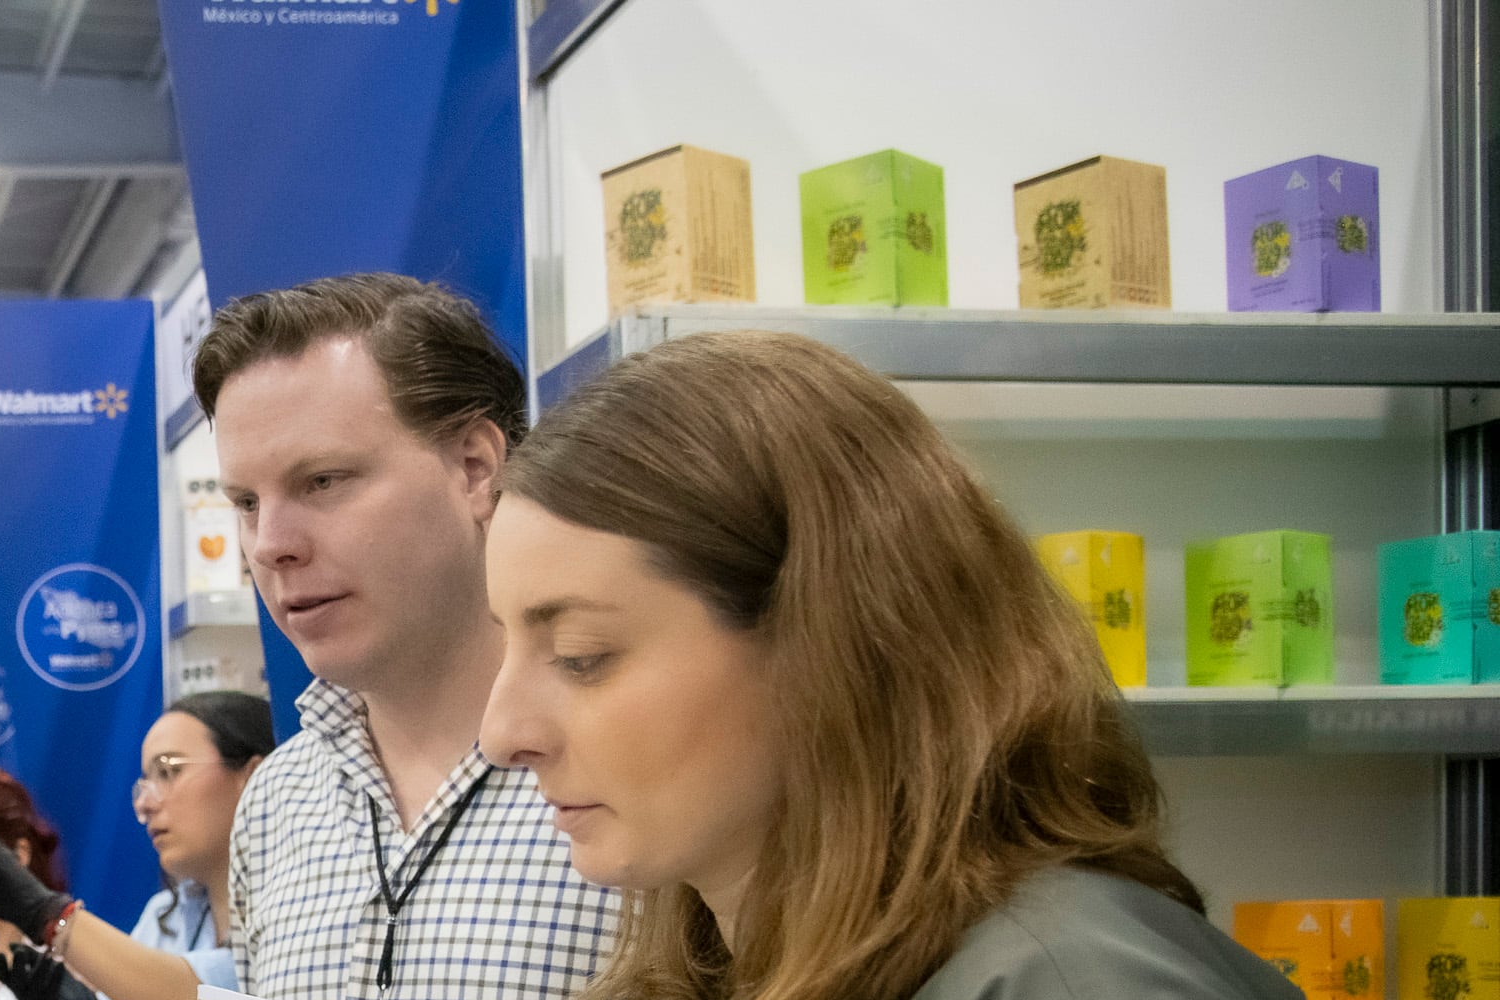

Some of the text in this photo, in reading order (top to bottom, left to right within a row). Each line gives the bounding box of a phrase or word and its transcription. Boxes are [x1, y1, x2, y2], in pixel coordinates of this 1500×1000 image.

[203, 8, 398, 25] México y Centroamérica
